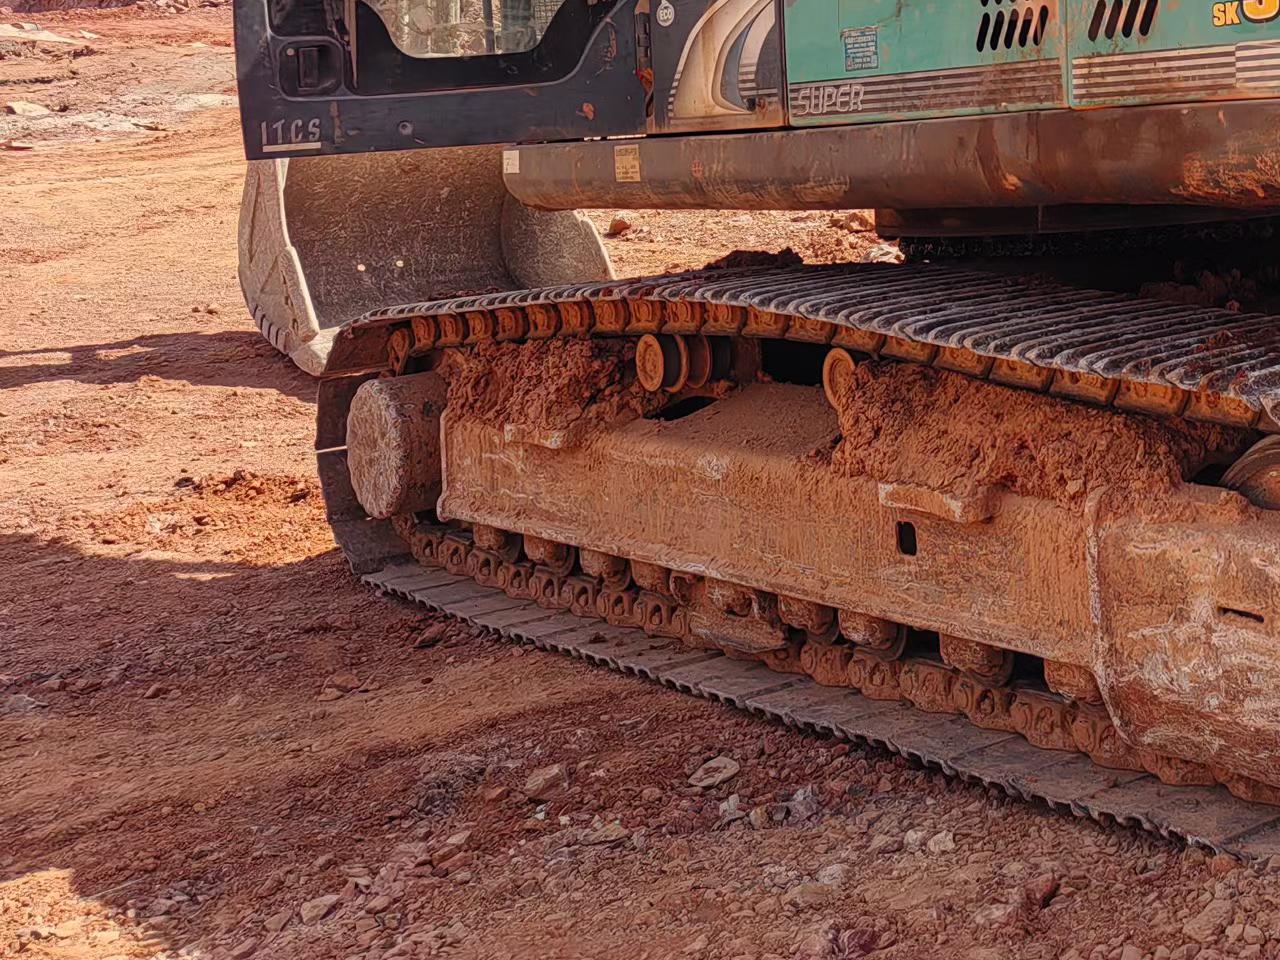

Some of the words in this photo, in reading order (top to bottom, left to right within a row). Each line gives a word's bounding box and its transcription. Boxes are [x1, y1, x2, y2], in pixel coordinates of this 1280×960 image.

[659, 8, 672, 20] ECO
[1212, 0, 1241, 27] SK
[797, 83, 864, 115] SUPER
[261, 118, 320, 145] ITCS
